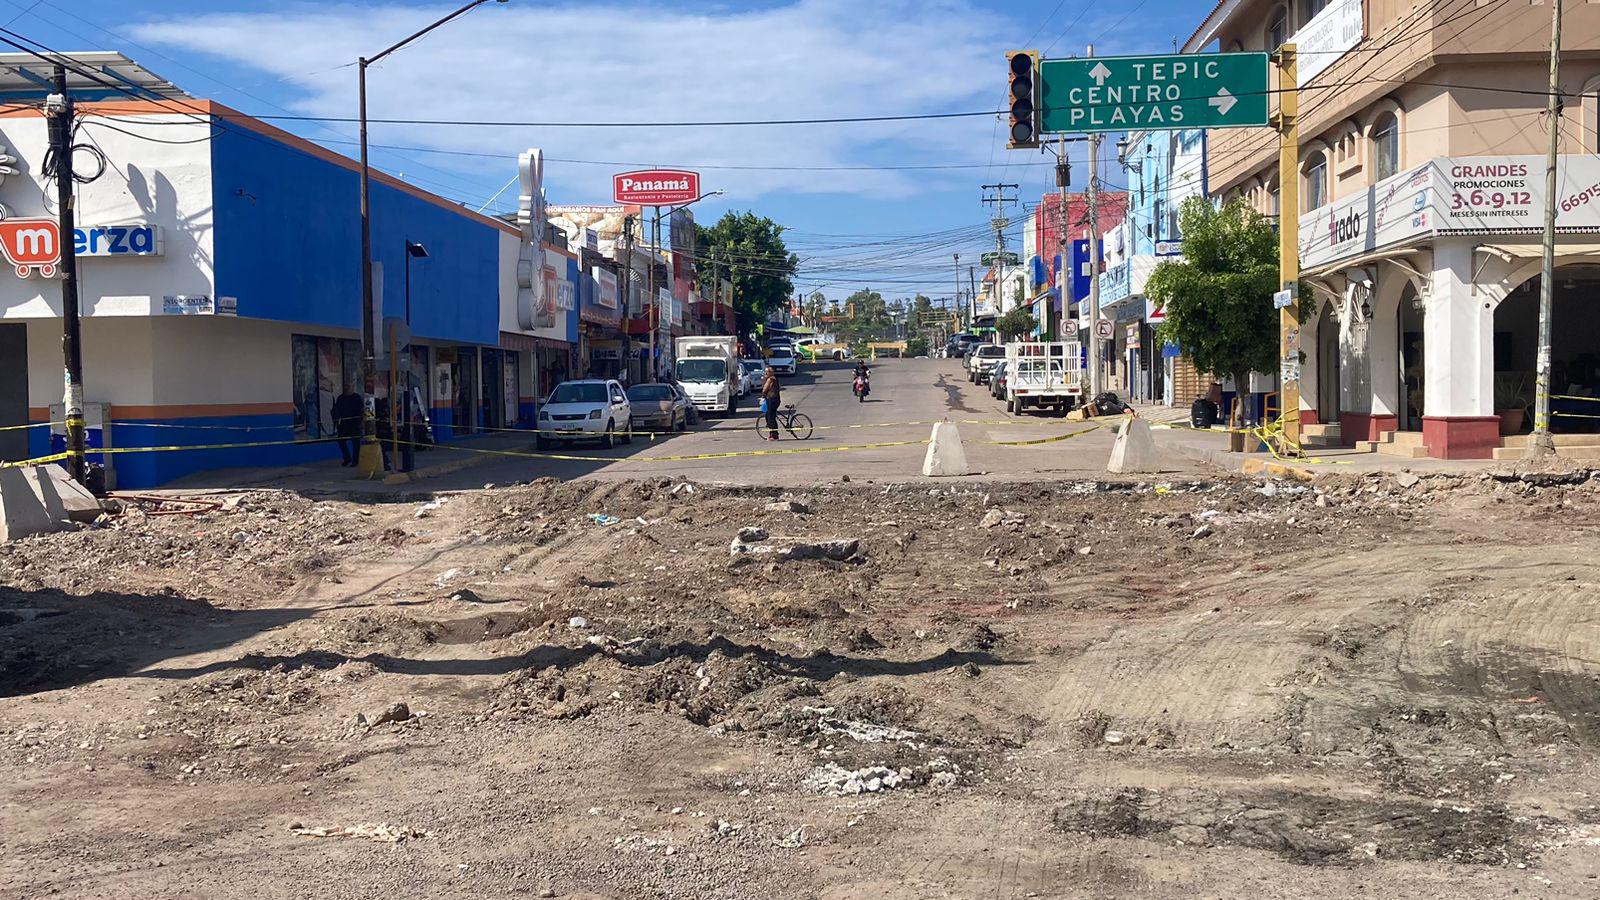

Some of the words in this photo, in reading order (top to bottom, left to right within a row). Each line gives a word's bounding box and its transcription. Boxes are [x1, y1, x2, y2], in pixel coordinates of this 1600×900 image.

[1132, 61, 1220, 81] TEPIC
[1069, 84, 1182, 105] CENTRO
[1070, 105, 1185, 126] PLAYAS
[1451, 164, 1528, 178] GRANDES
[621, 177, 689, 192] Panamá
[1453, 180, 1526, 189] PROMOCIONES
[1451, 189, 1532, 210] 3.6.9.12
[1450, 210, 1474, 218] MESES
[1329, 206, 1360, 246] tirado
